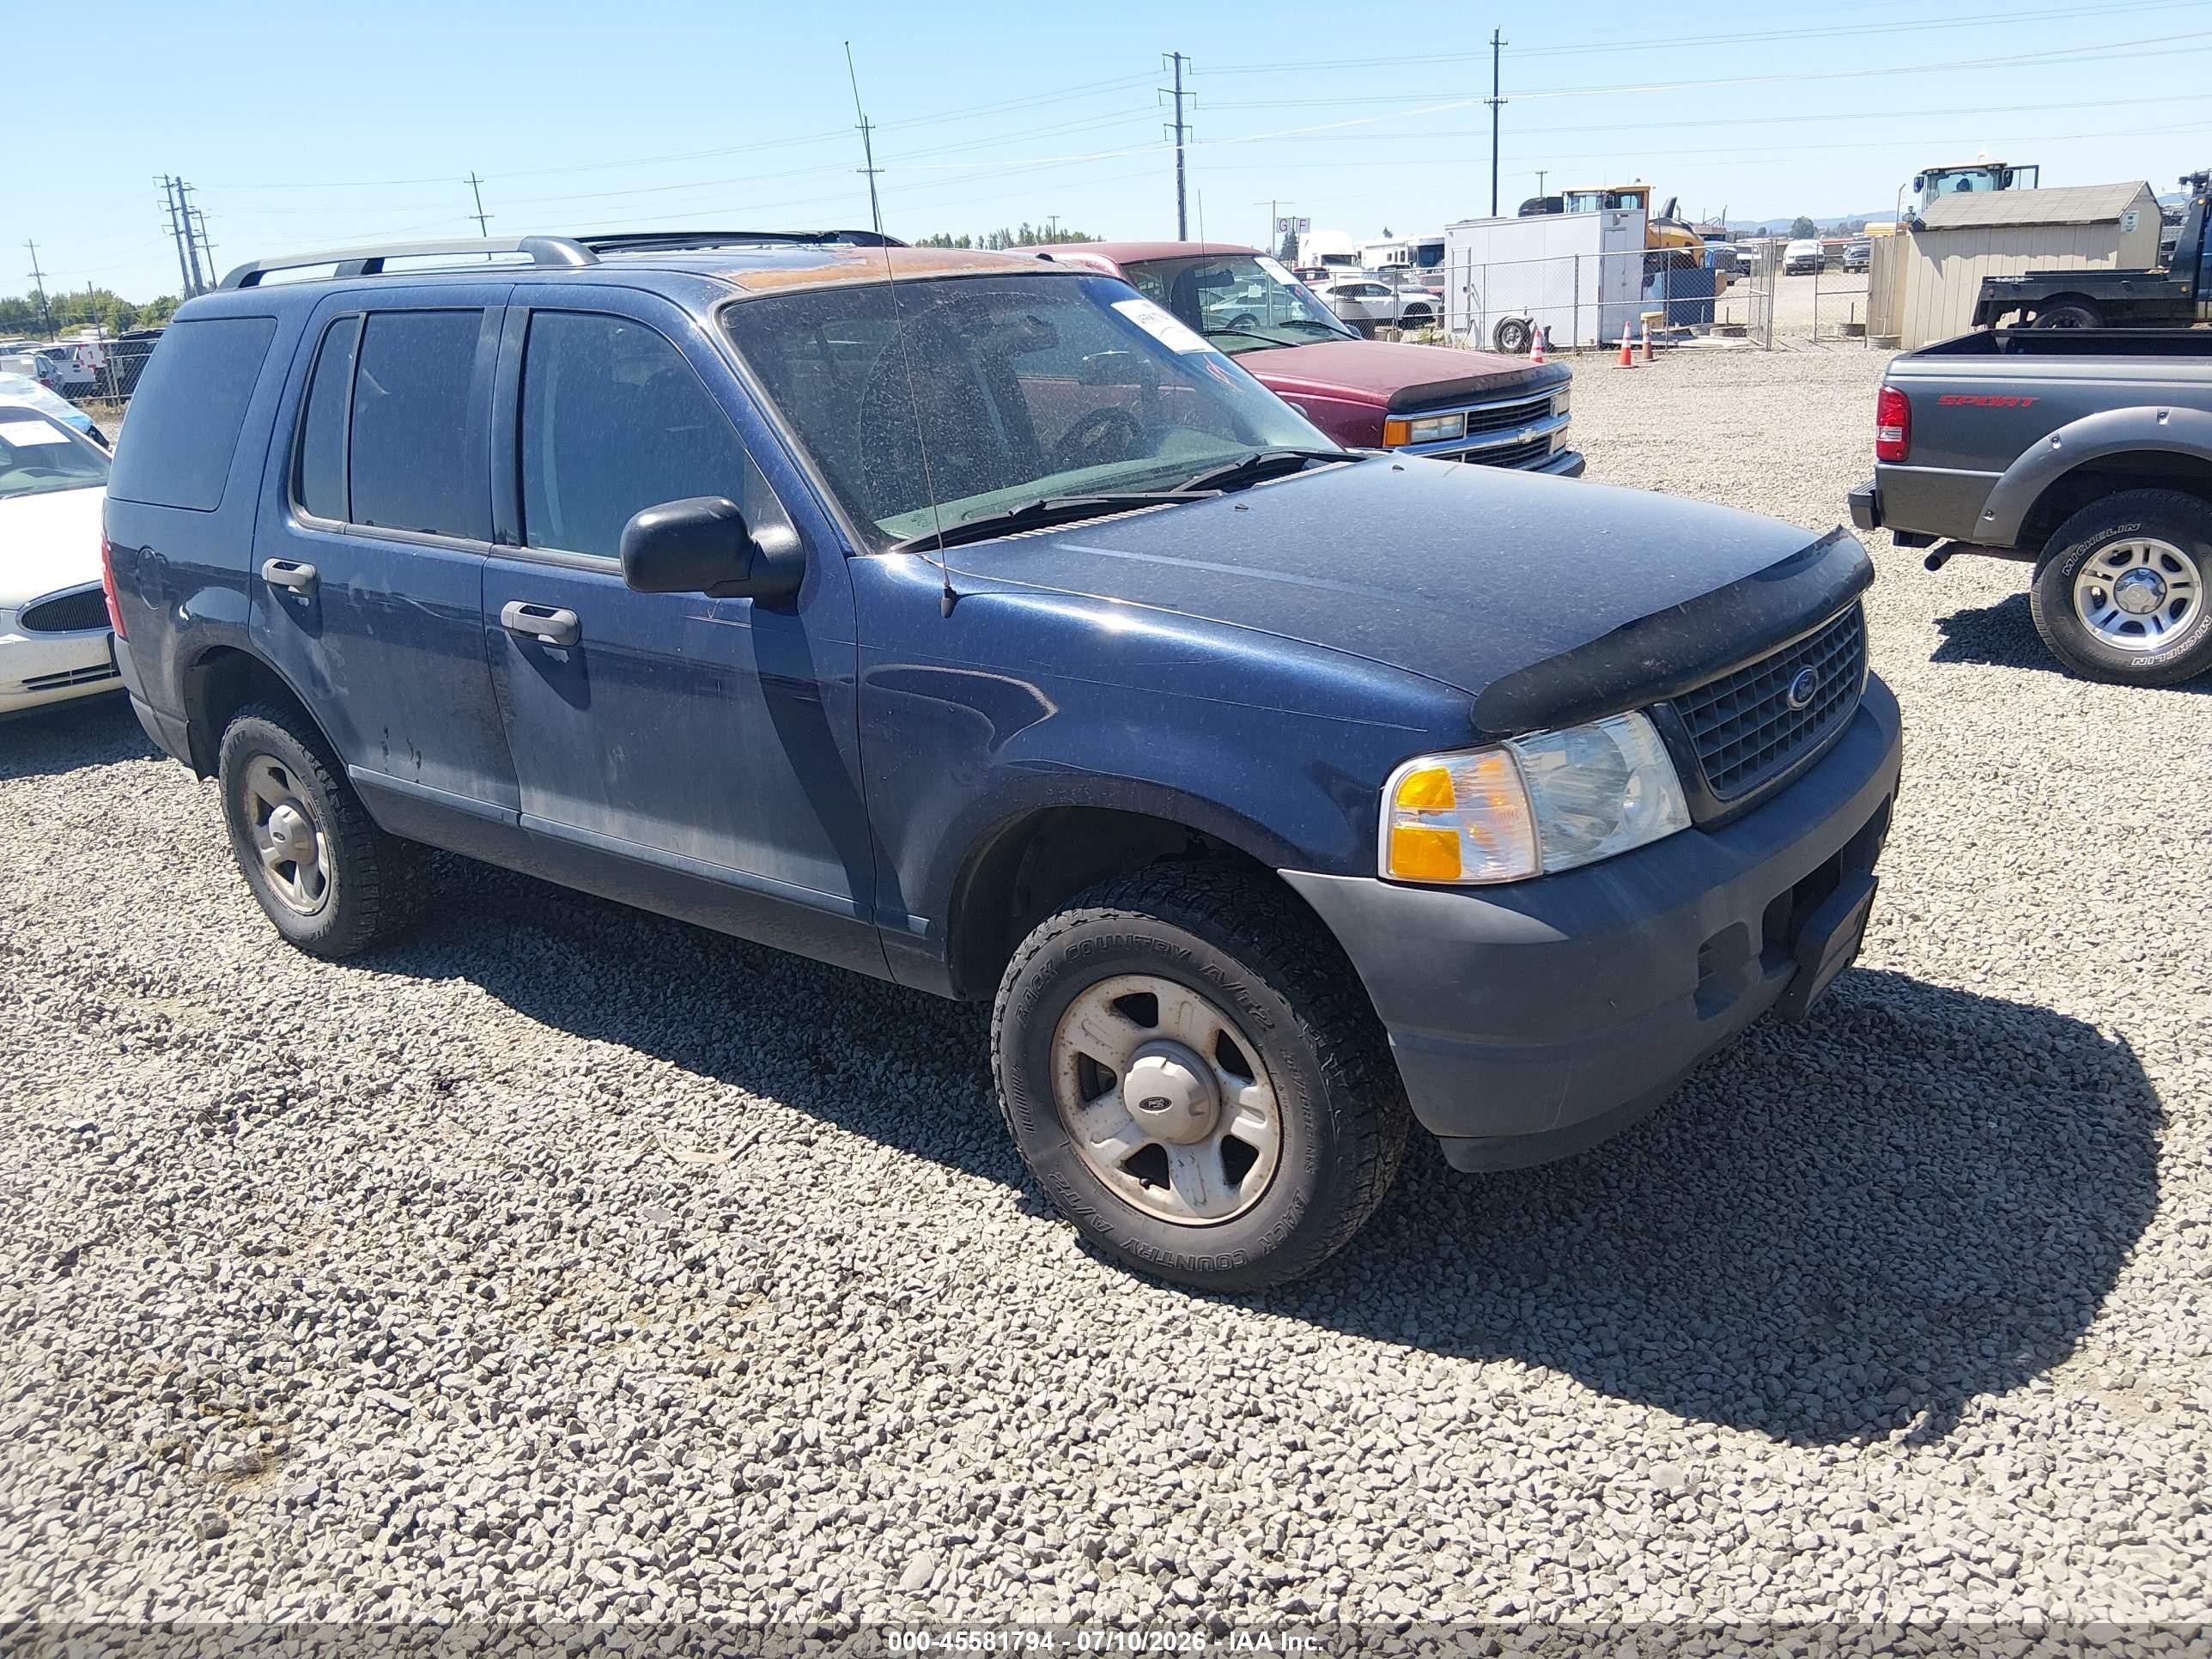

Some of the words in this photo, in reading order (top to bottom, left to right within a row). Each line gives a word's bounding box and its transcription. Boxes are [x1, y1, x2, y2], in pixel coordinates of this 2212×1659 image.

[1279, 218, 1288, 232] G
[1299, 219, 1306, 232] F
[88, 350, 94, 359] 1
[1937, 394, 2039, 407] SPORT
[2062, 523, 2141, 576] MICHELIN
[2131, 615, 2212, 666] MICHELIN
[1015, 959, 1059, 1025] BACK
[1063, 933, 1194, 962] COUNTRY
[1200, 961, 1276, 1031] A/T2
[1048, 1170, 1114, 1233] A/T2
[1257, 1186, 1310, 1257] BACK
[1119, 1237, 1248, 1272] COUNTRY
